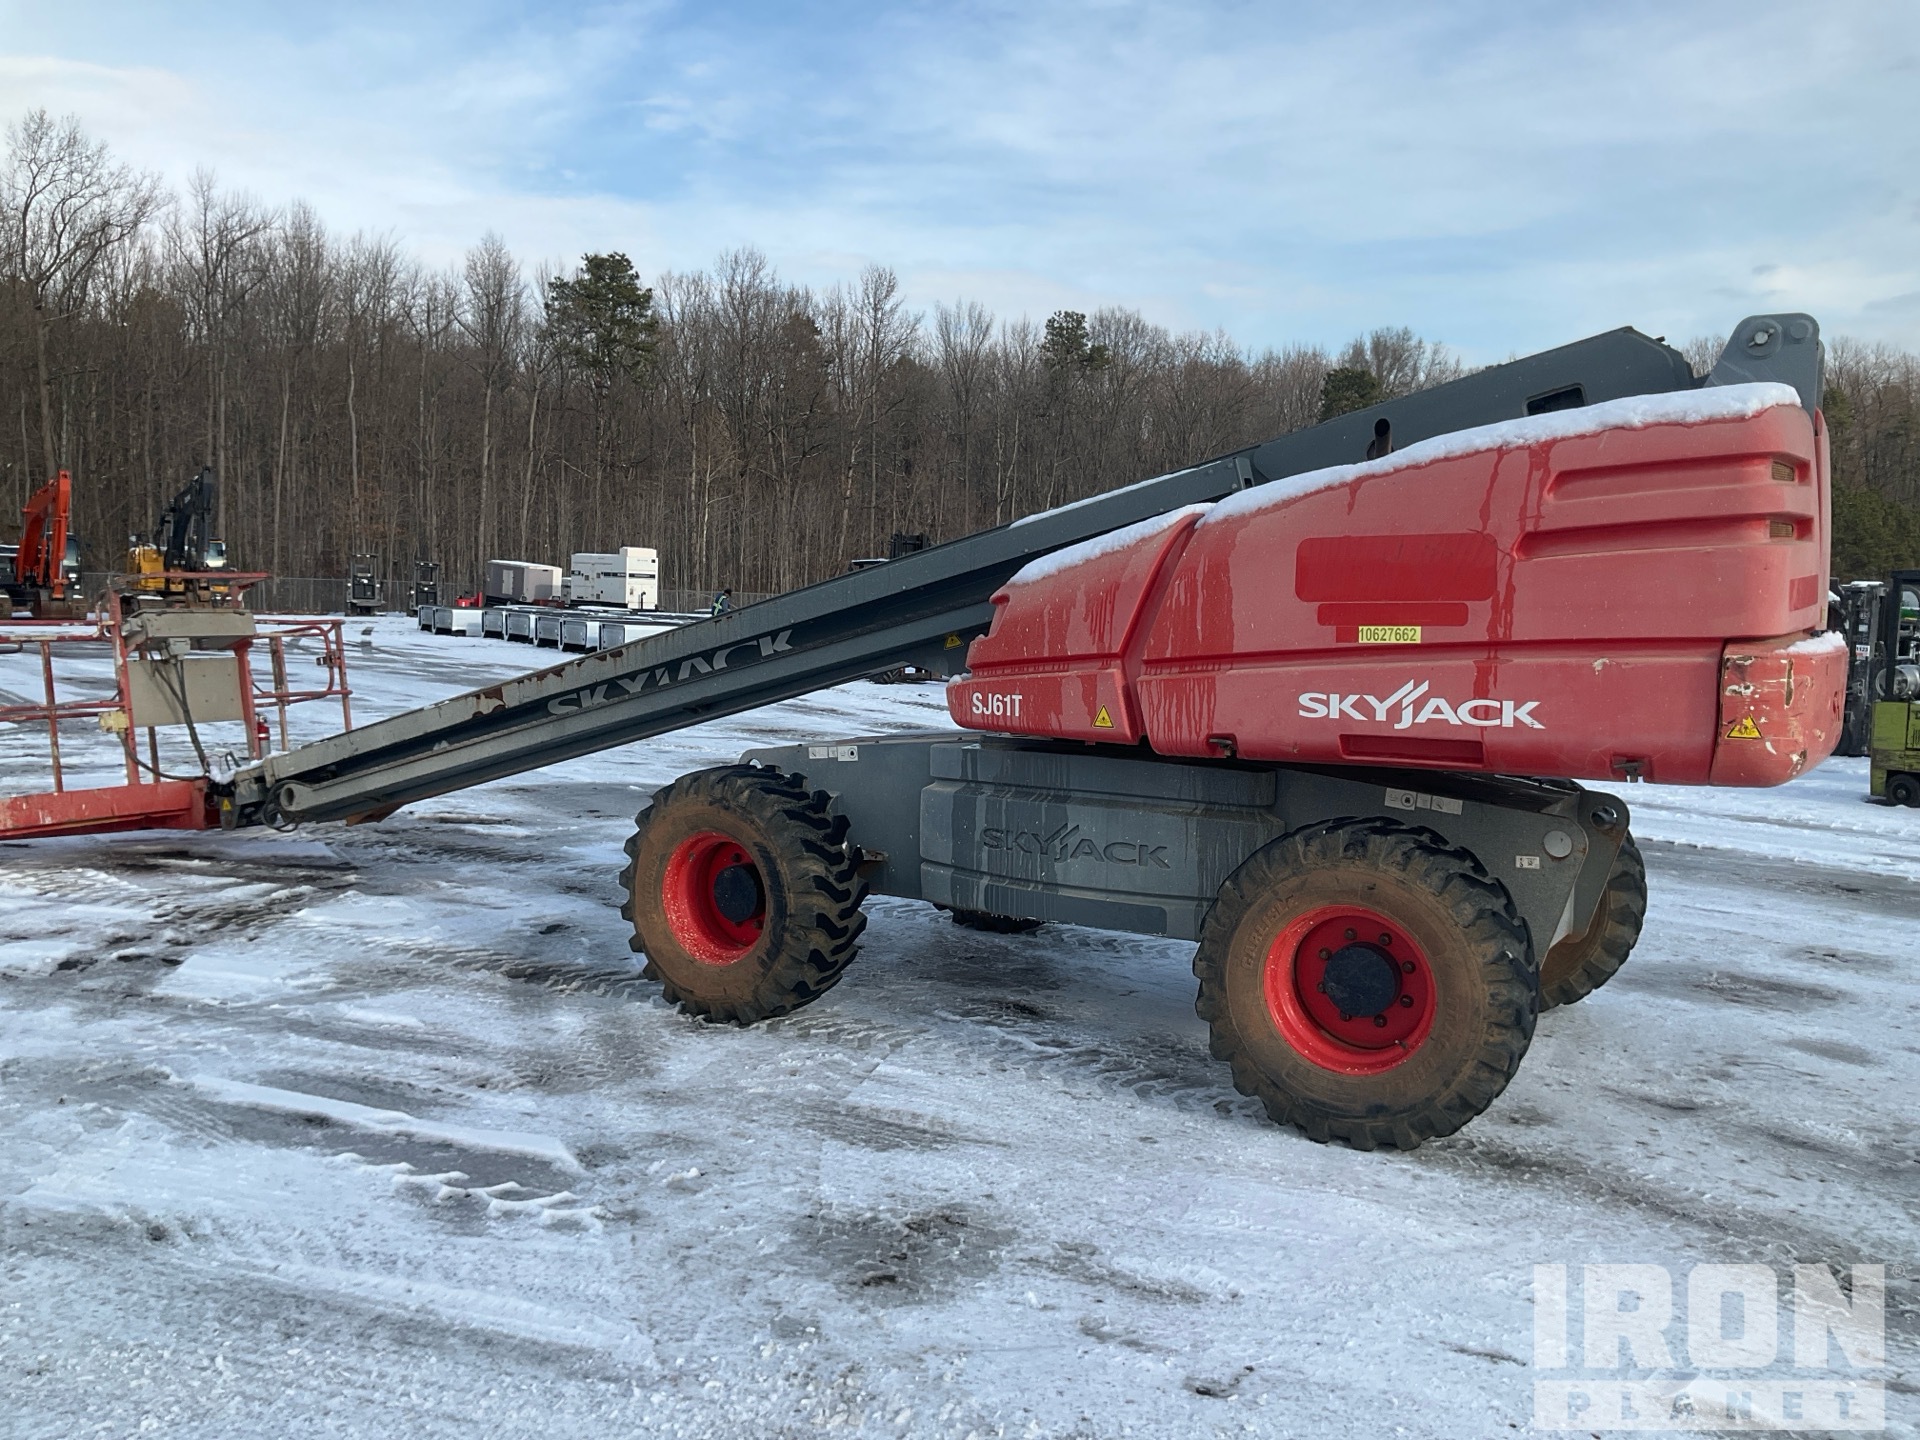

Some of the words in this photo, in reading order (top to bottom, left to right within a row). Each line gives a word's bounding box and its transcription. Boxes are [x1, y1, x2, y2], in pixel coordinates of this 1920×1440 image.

[1359, 627, 1417, 642] 10627662
[971, 691, 1023, 717] SJ61T
[1298, 679, 1546, 730] SKYJACK
[982, 822, 1171, 870] SKYJACK
[1240, 894, 1299, 970] CARLISLE
